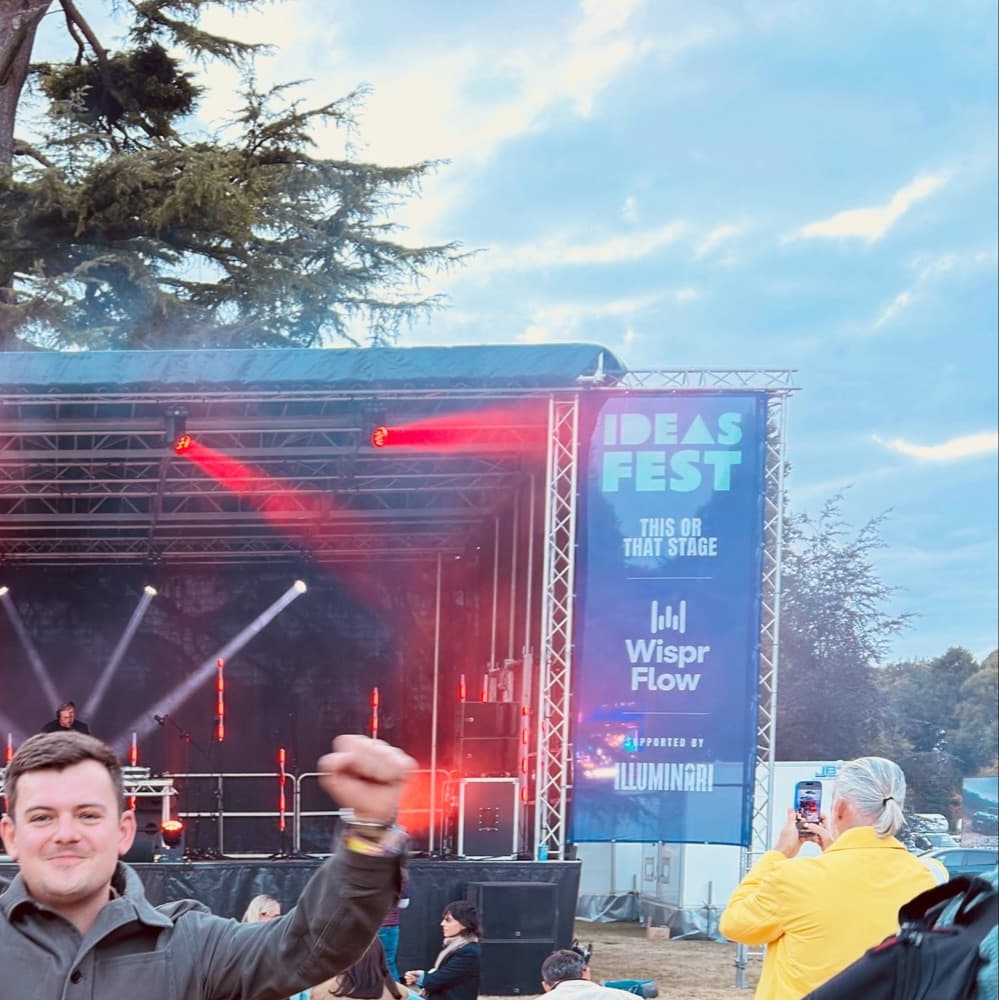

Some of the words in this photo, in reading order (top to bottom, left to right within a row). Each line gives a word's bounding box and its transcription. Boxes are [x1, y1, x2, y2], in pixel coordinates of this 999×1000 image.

[603, 412, 743, 446] IDEAS
[602, 450, 742, 492] FEST
[640, 518, 675, 537] THIS
[680, 518, 701, 537] OR
[623, 537, 662, 557] THAT
[668, 537, 717, 557] STAGE
[625, 639, 711, 668] Wispr
[631, 667, 701, 691] Flow
[691, 738, 704, 748] BY
[614, 763, 714, 792] ILLUMINARI
